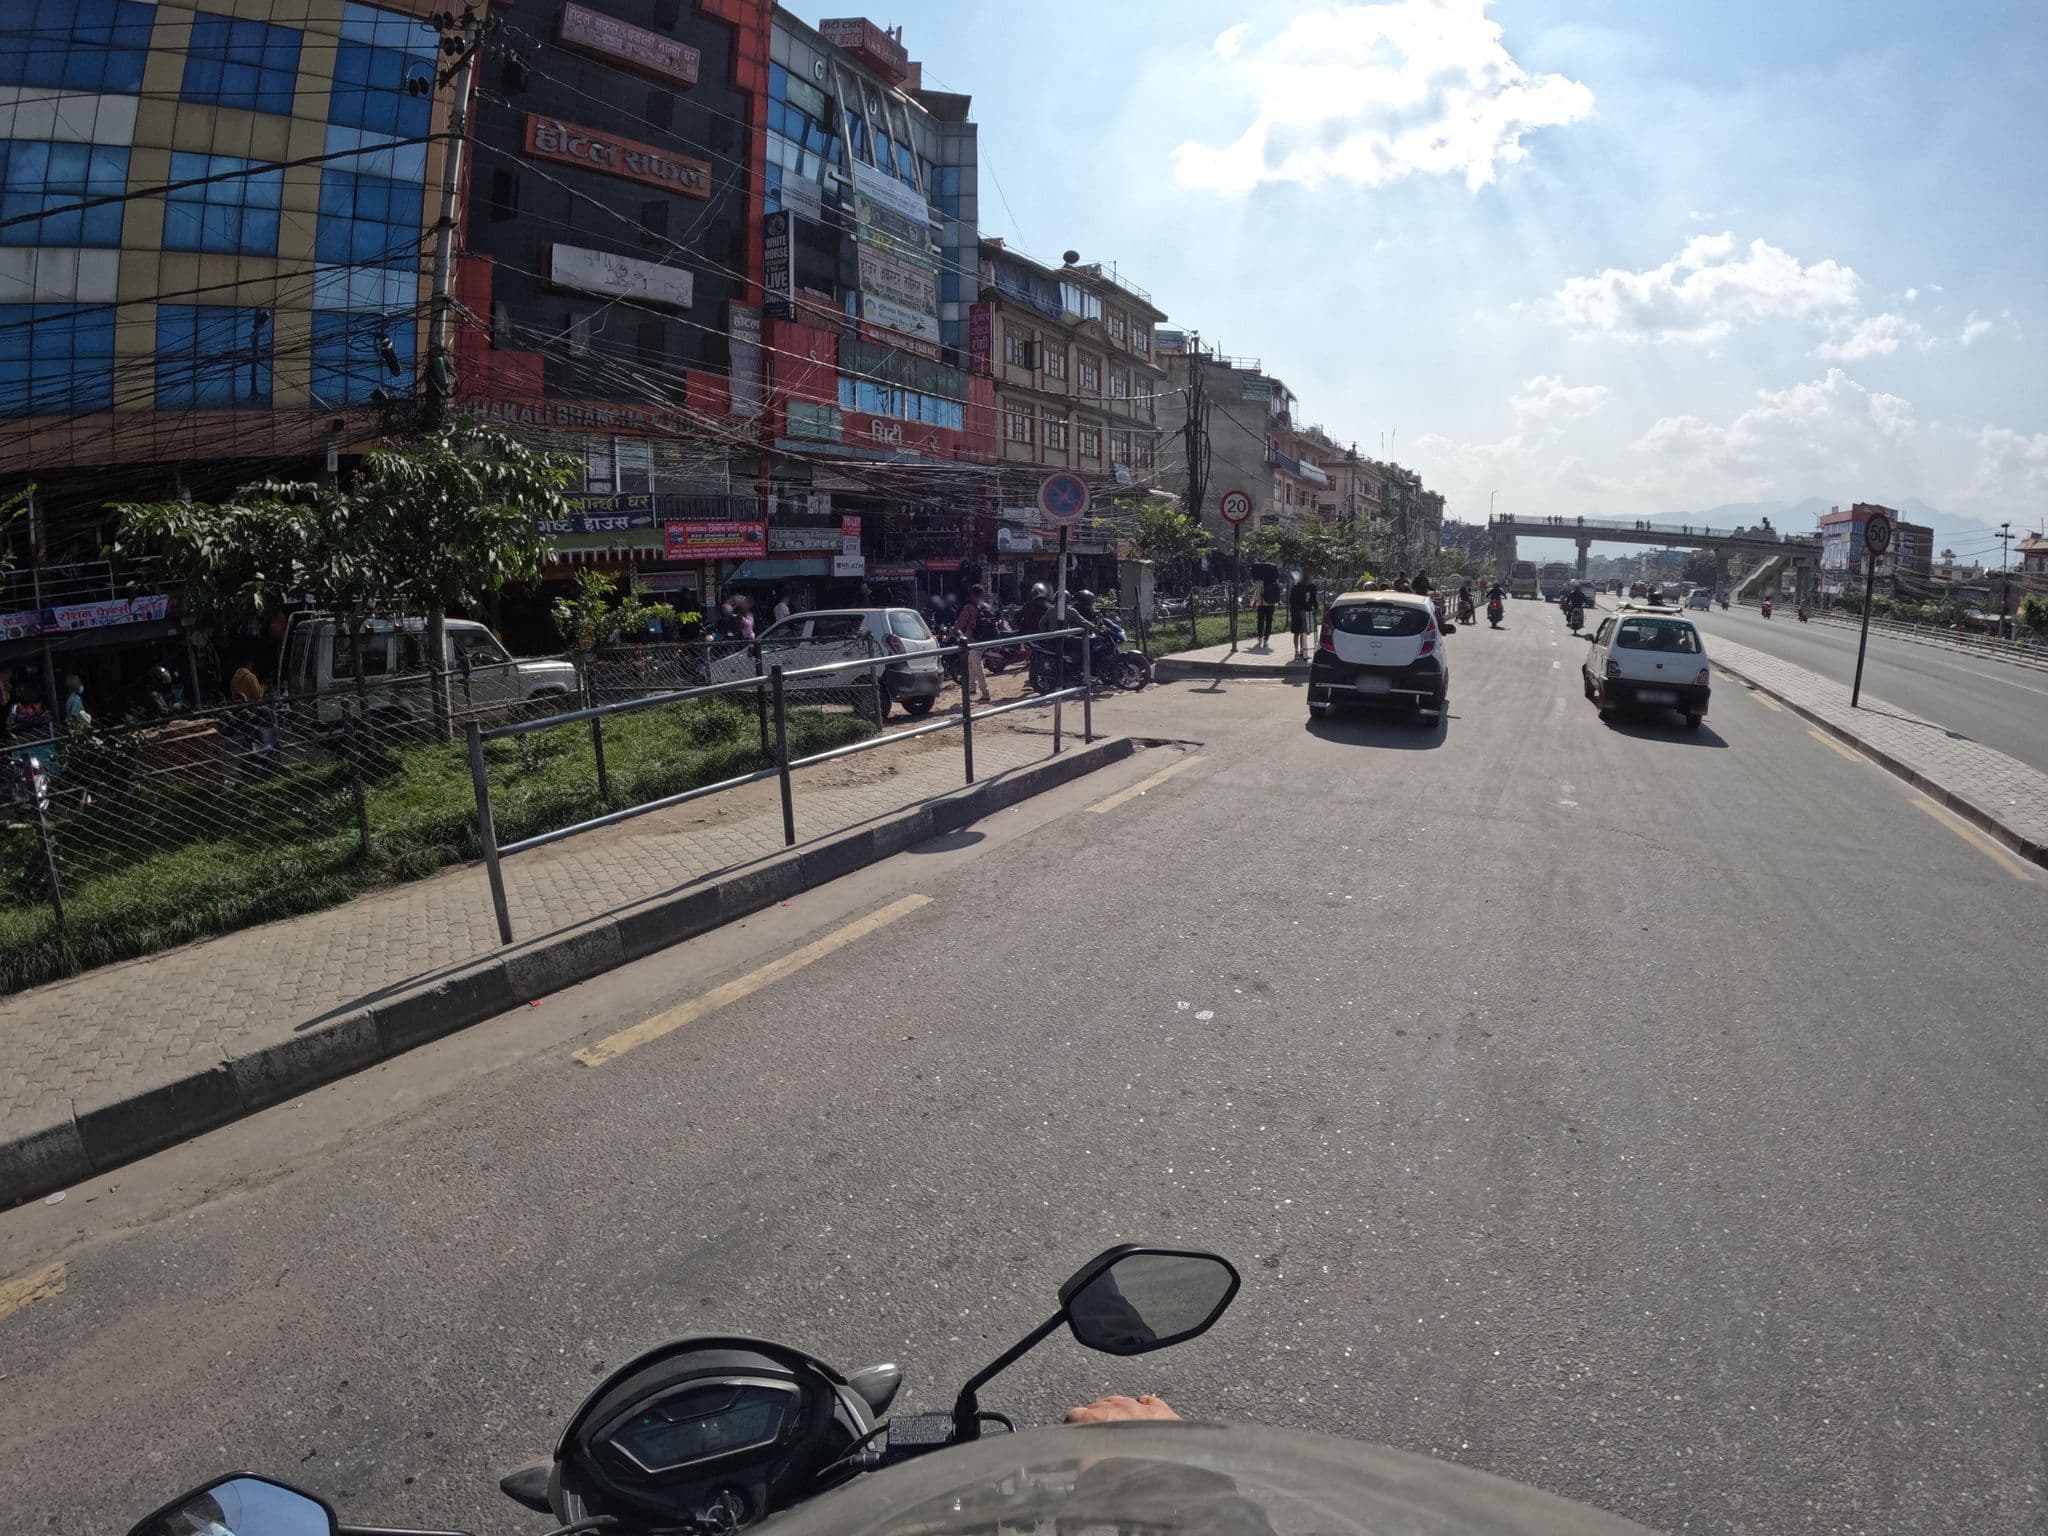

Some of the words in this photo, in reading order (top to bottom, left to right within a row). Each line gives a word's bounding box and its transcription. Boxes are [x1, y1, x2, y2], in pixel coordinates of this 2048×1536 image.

[567, 6, 592, 26] होटल
[535, 120, 619, 166] होटल
[624, 150, 707, 190] सफल
[765, 234, 788, 249] WHITE
[764, 246, 788, 261] HORSE
[765, 270, 788, 289] LIVE
[733, 313, 761, 329] होटल
[870, 418, 904, 446] सिटी
[627, 494, 651, 510] घर
[1228, 499, 1246, 513] 20
[583, 515, 630, 533] हाउस
[1869, 524, 1886, 542] 50
[57, 608, 92, 621] रोशन
